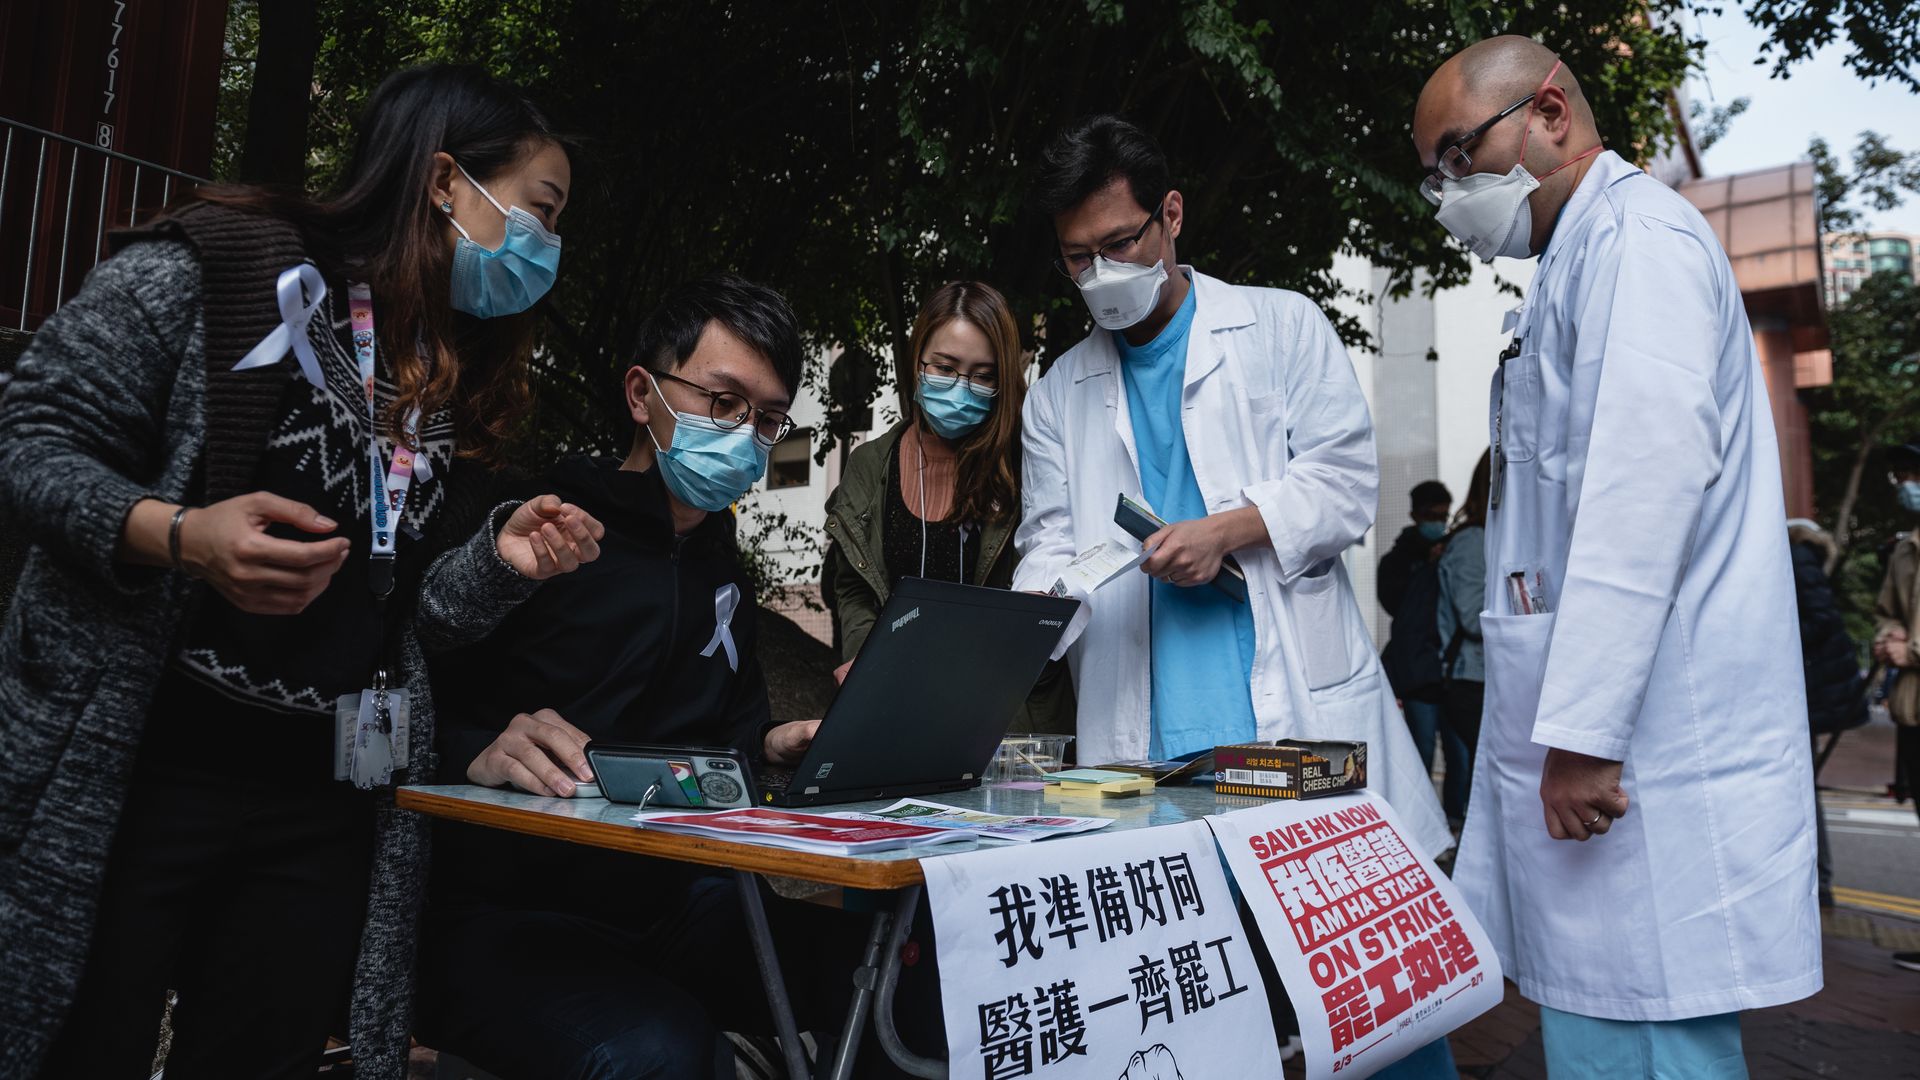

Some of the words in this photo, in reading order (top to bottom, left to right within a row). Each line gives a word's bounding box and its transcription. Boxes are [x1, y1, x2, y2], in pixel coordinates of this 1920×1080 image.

[103, 0, 125, 114] 77617
[98, 125, 110, 148] 8
[1302, 766, 1323, 779] REAL
[1302, 777, 1332, 792] CHEESE
[1249, 822, 1313, 860] SAVE
[1305, 814, 1343, 840] HK
[1333, 802, 1381, 831] NOW
[987, 852, 1205, 969] 我準備好同
[1267, 826, 1418, 920] 我係醫護
[1295, 922, 1310, 948] I
[1309, 905, 1348, 942] AM
[1342, 892, 1379, 923] HA
[1372, 866, 1427, 906] STAFF
[1309, 938, 1361, 989] ON
[1358, 891, 1454, 961] STRIKE
[1470, 972, 1484, 988] 2/7
[977, 935, 1249, 1080] 醫護一齊罷工
[1321, 920, 1479, 1054] 罷工救港
[1332, 1054, 1352, 1074] 2/3
